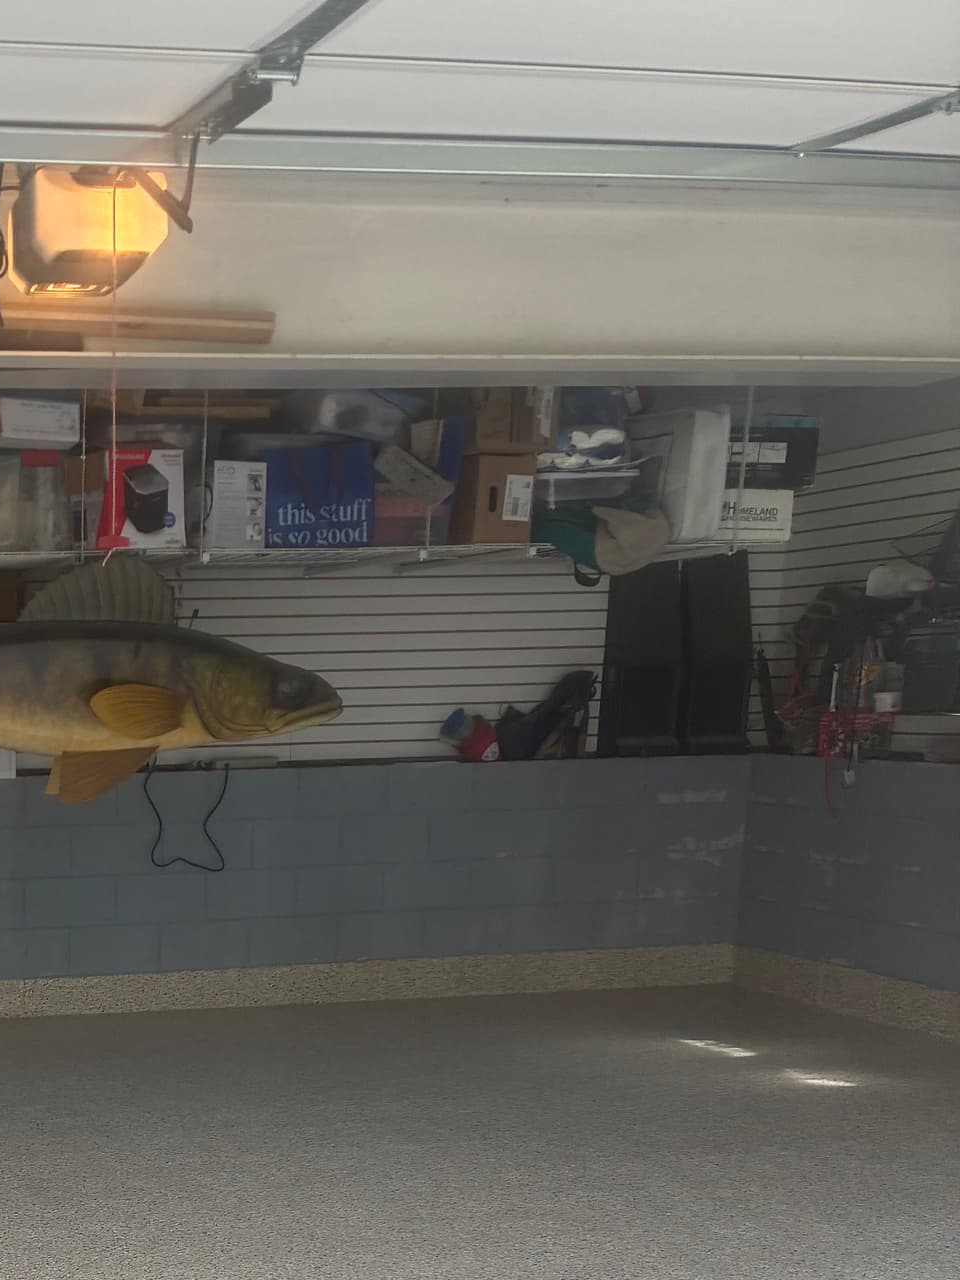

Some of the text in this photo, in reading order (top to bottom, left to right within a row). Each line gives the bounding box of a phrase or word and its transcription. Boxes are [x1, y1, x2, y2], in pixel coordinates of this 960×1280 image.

[278, 497, 372, 526] this stuff
[268, 521, 368, 547] is so good
